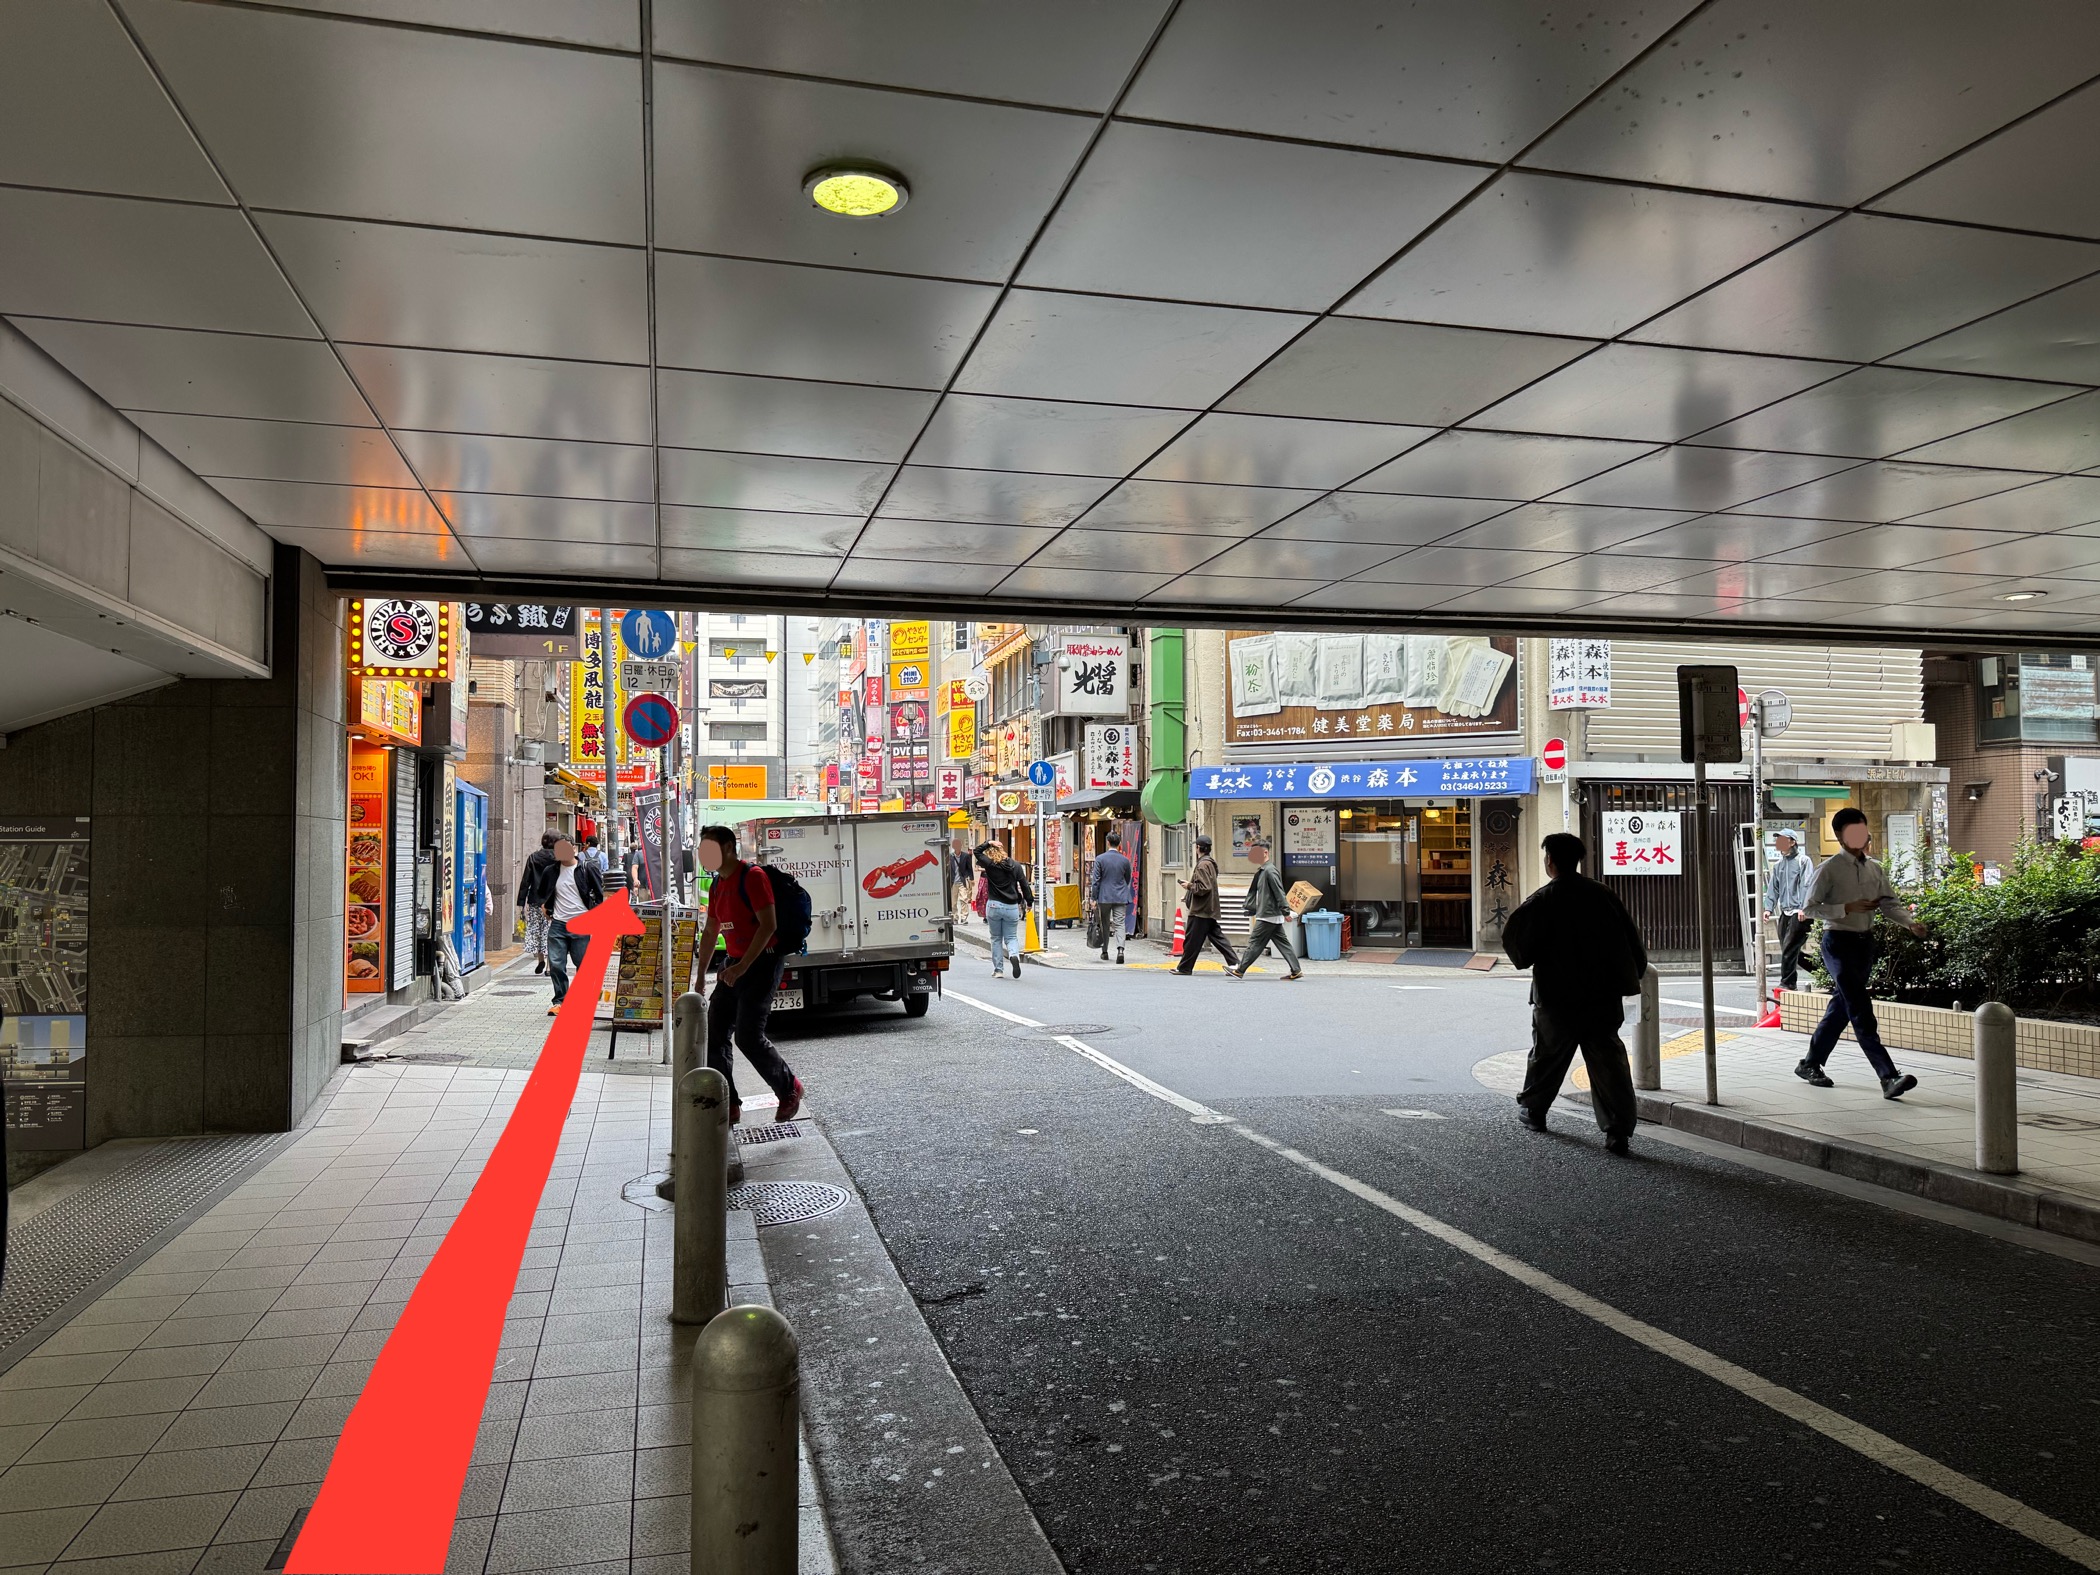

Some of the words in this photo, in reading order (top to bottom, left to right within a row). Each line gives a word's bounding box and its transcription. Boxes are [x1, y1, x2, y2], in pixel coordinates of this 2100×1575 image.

[371, 601, 406, 656] SHIBUYA
[406, 604, 433, 656] KEBAB
[390, 617, 413, 643] S
[1556, 646, 1570, 681] 森本
[1584, 644, 1602, 680] 森本
[584, 630, 603, 709] 博多風龍
[624, 665, 675, 676] 日曜・休日の
[627, 678, 638, 687] 12
[661, 678, 671, 688] 17
[1246, 664, 1260, 692] 粉茶
[1552, 694, 1574, 705] 喜久水
[1579, 693, 1608, 704] 喜久水
[1312, 713, 1414, 734] 健美堂薬局
[1236, 727, 1305, 737] Fax:03-3461-1784
[1105, 751, 1119, 778] 森本
[1123, 746, 1133, 776] 喜久水
[1442, 760, 1508, 769] 元祖つくね焼
[353, 772, 374, 781] OK!
[1266, 768, 1297, 779] うなぎ
[1341, 774, 1361, 783] 渋谷
[1367, 768, 1418, 788] 森本
[1442, 771, 1508, 780] お土産承ります
[1206, 774, 1252, 789] 喜久水
[1440, 782, 1507, 791] 03(3464)5233
[1314, 815, 1332, 824] 森本
[1658, 820, 1676, 830] 森本
[1610, 840, 1675, 866] 喜久水
[818, 860, 851, 868] FINEST
[1484, 860, 1513, 929] 森本
[877, 907, 929, 921] EBISHO
